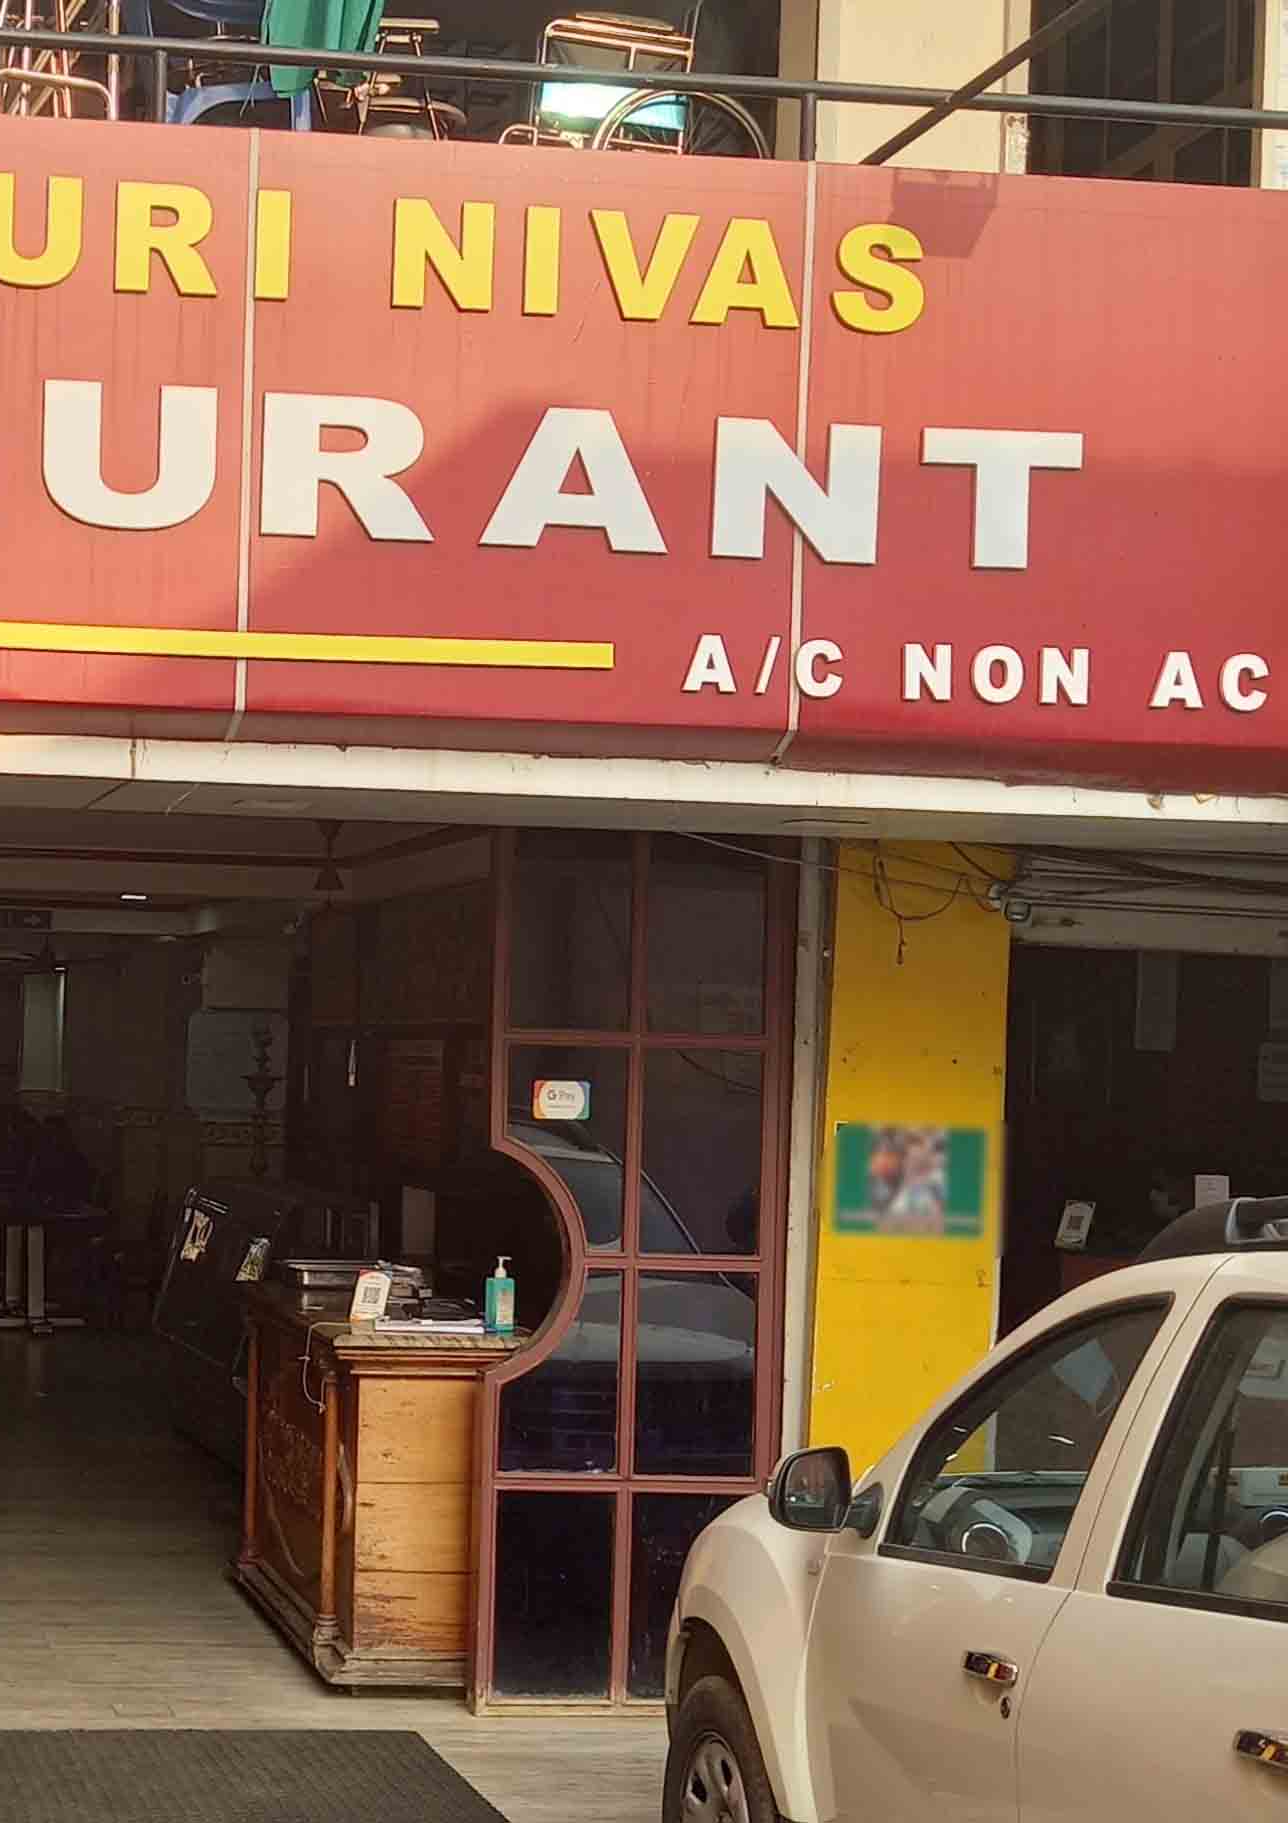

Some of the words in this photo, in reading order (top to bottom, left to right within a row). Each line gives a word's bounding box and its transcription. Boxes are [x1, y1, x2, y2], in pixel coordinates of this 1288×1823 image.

[392, 196, 925, 333] NIVAS
[681, 634, 844, 698] A/C
[903, 642, 1090, 705] NON
[1149, 651, 1270, 712] AC
